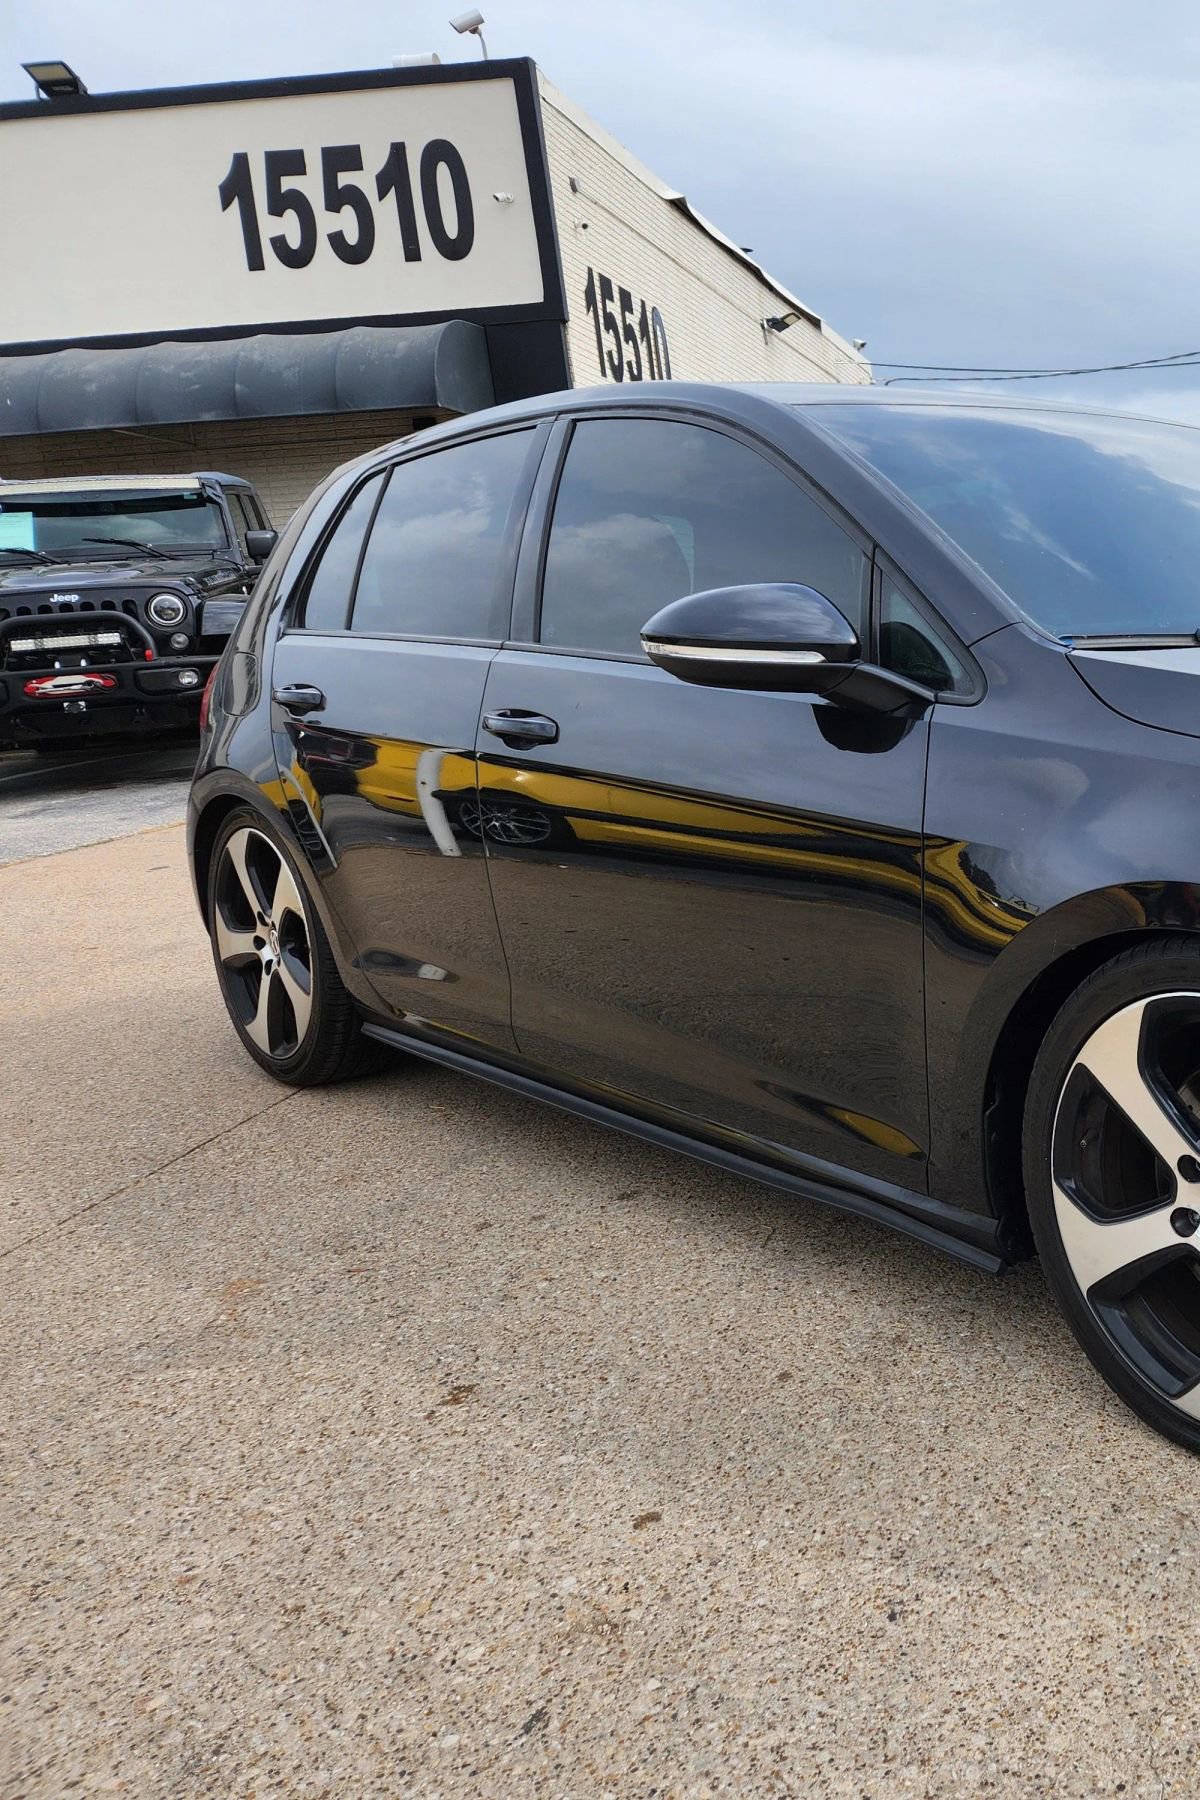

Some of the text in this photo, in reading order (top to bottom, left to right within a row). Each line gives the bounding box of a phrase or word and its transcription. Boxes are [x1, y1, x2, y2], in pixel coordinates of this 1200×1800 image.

[218, 138, 475, 271] 15510
[585, 266, 672, 383] 15510
[49, 593, 79, 603] Jeep
